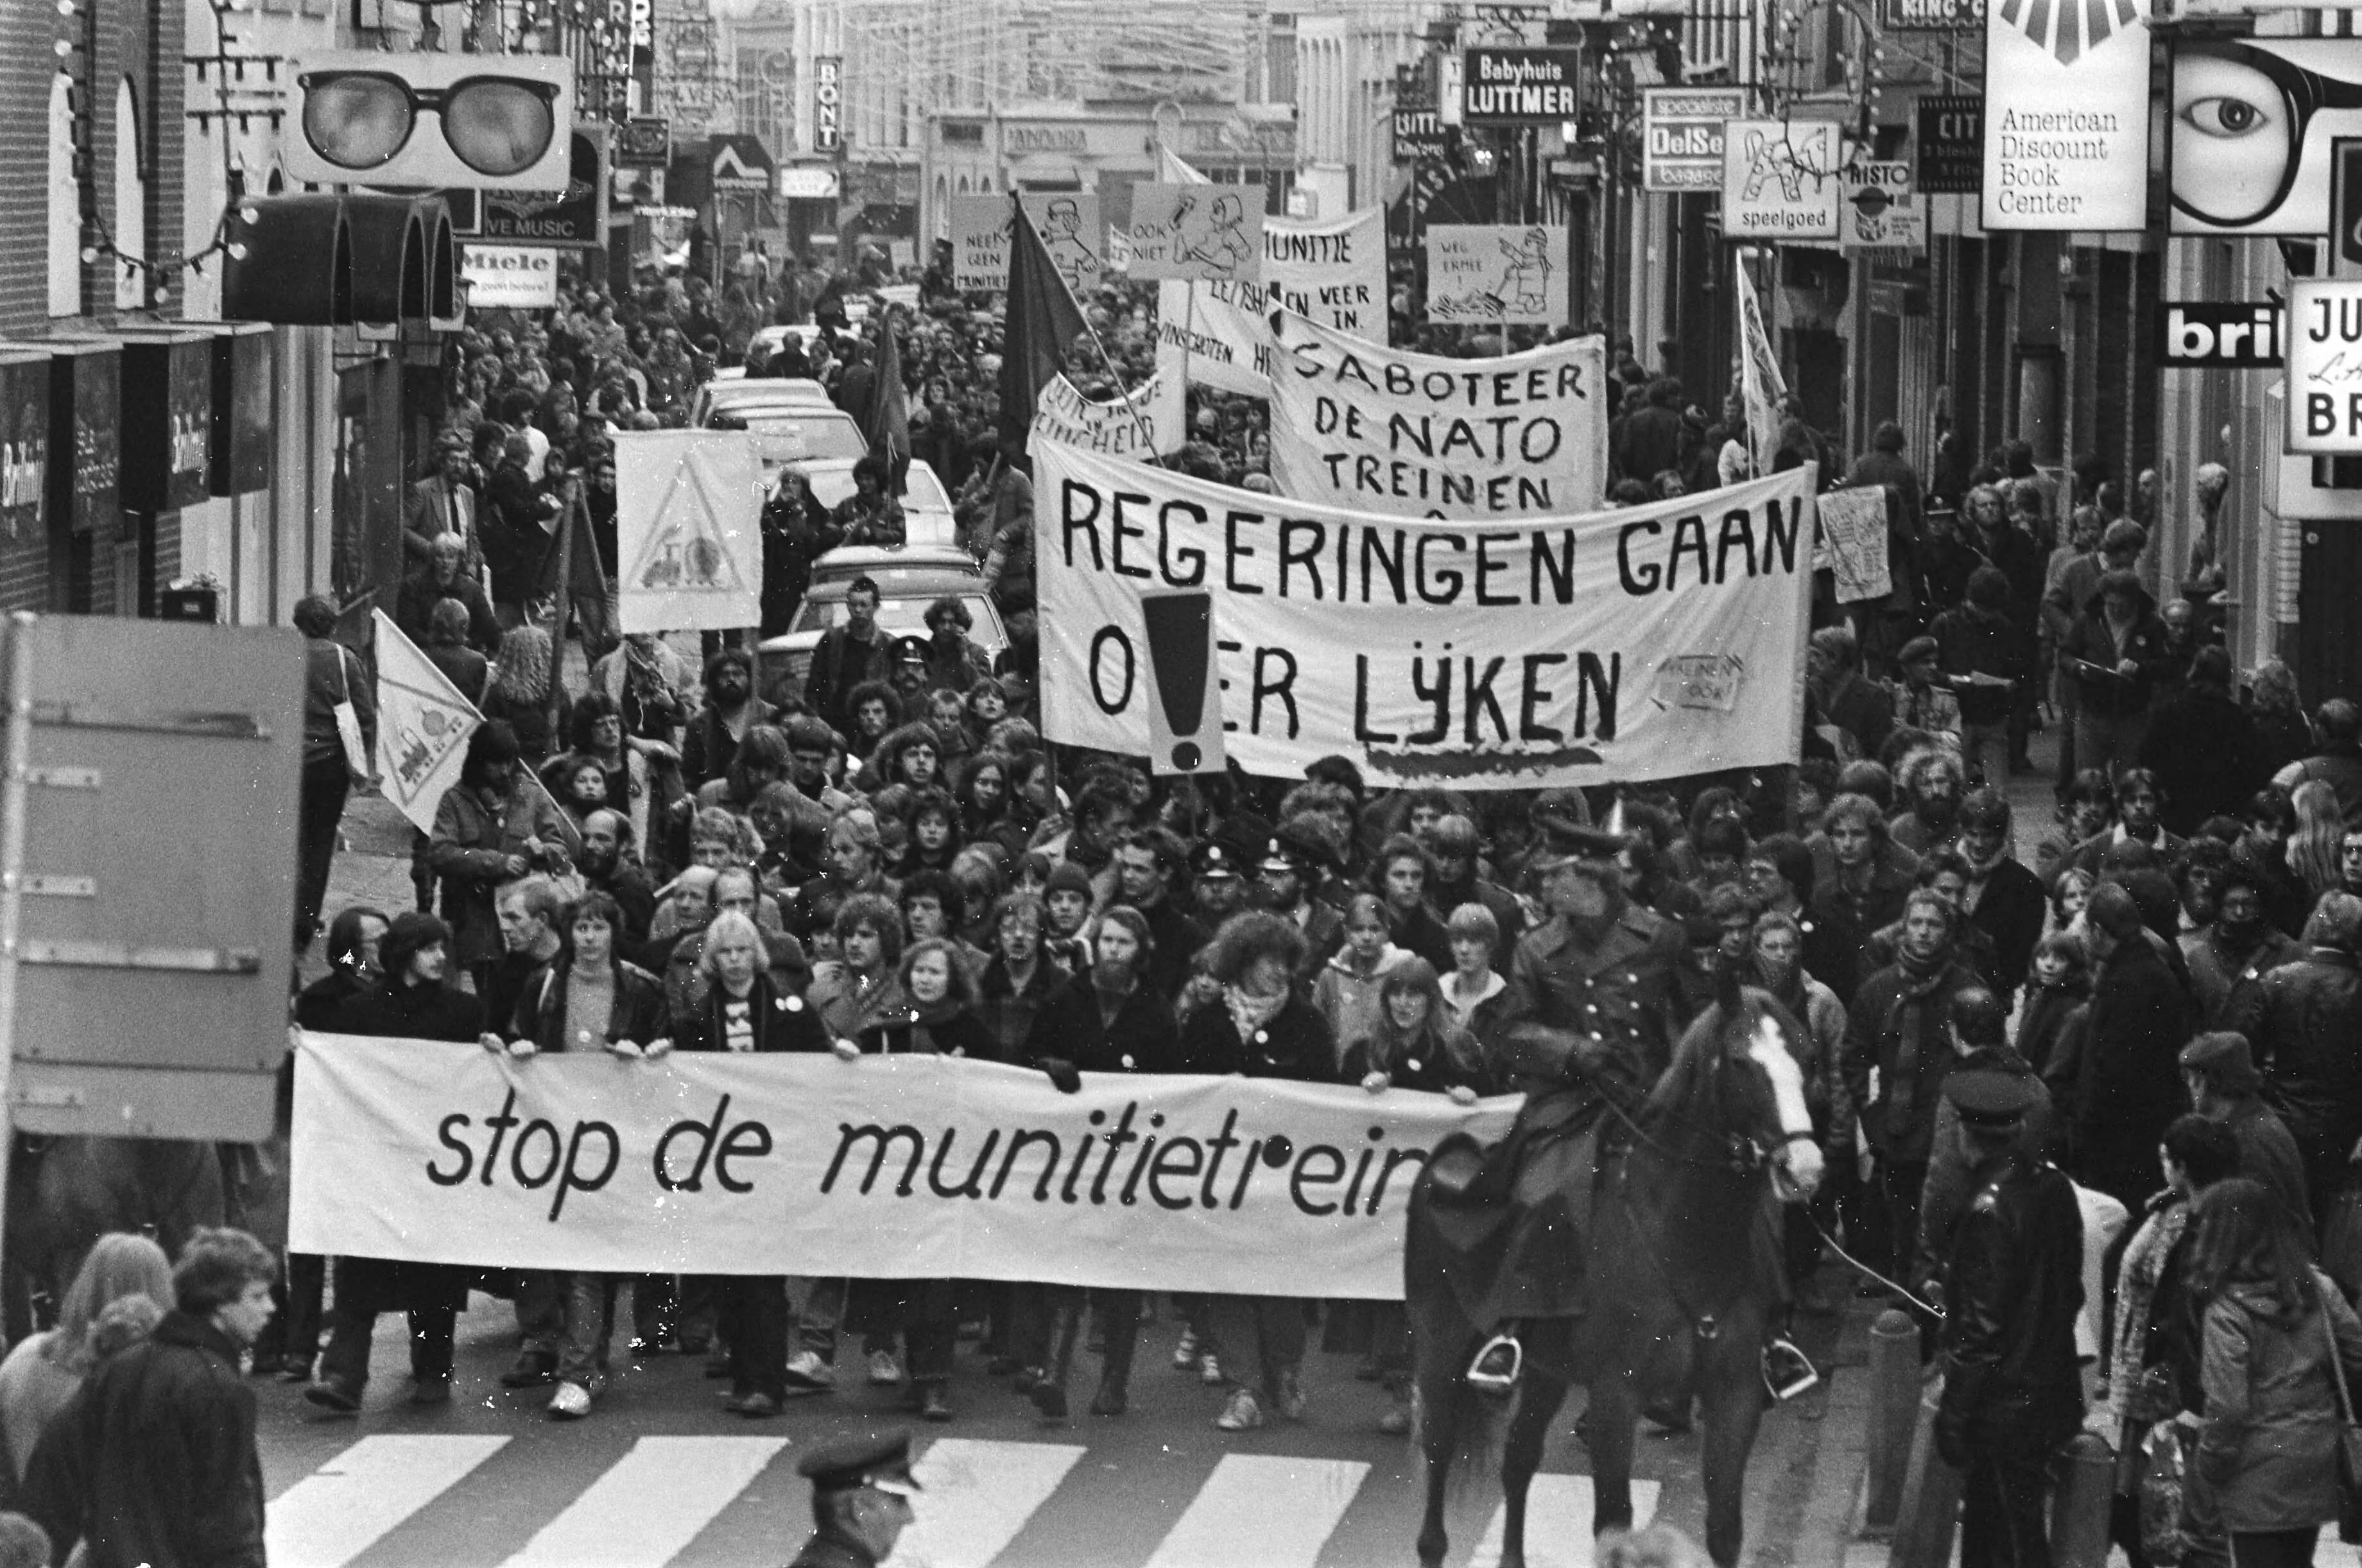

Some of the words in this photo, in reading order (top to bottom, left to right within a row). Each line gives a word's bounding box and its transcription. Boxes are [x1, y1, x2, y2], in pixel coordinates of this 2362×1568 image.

[1480, 55, 1562, 87] Babyhuis
[818, 64, 838, 146] BONT
[1468, 85, 1574, 114] LUTTMER
[1999, 107, 2118, 132] American
[1999, 136, 2107, 160] Discount
[2000, 164, 2060, 187] Book
[1999, 192, 2082, 214] Center
[515, 220, 575, 237] MUSIC
[1742, 209, 1826, 230] speelgoed
[1133, 246, 1166, 260] NIET
[1293, 343, 1587, 406] SABOTEER
[1315, 397, 1365, 440] DE
[1388, 413, 1562, 465] NATO
[1323, 452, 1552, 511] TREINEN
[1062, 478, 1575, 605] REGERINGEN
[1617, 496, 1802, 596] GAAN
[1090, 624, 1298, 739] OER
[427, 1087, 620, 1222] stop
[653, 1094, 772, 1193] de
